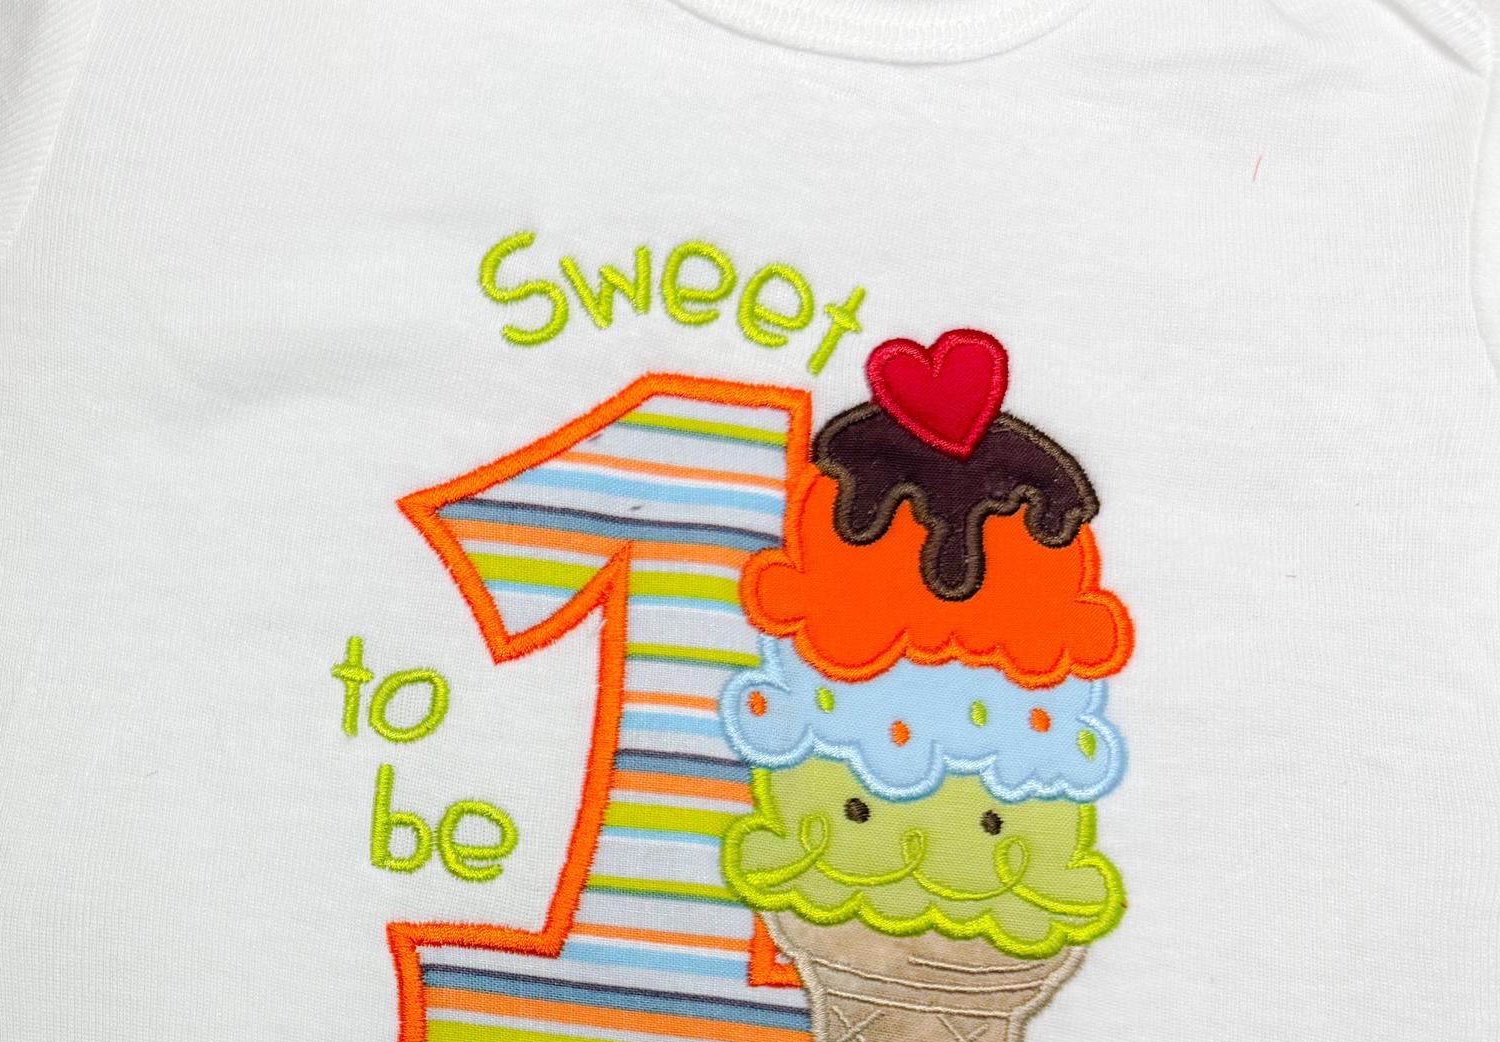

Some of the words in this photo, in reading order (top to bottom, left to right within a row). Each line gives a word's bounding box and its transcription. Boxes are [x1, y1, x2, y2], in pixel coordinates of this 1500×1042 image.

[478, 231, 868, 376] Sweet
[331, 635, 452, 745] to
[369, 763, 520, 884] be
